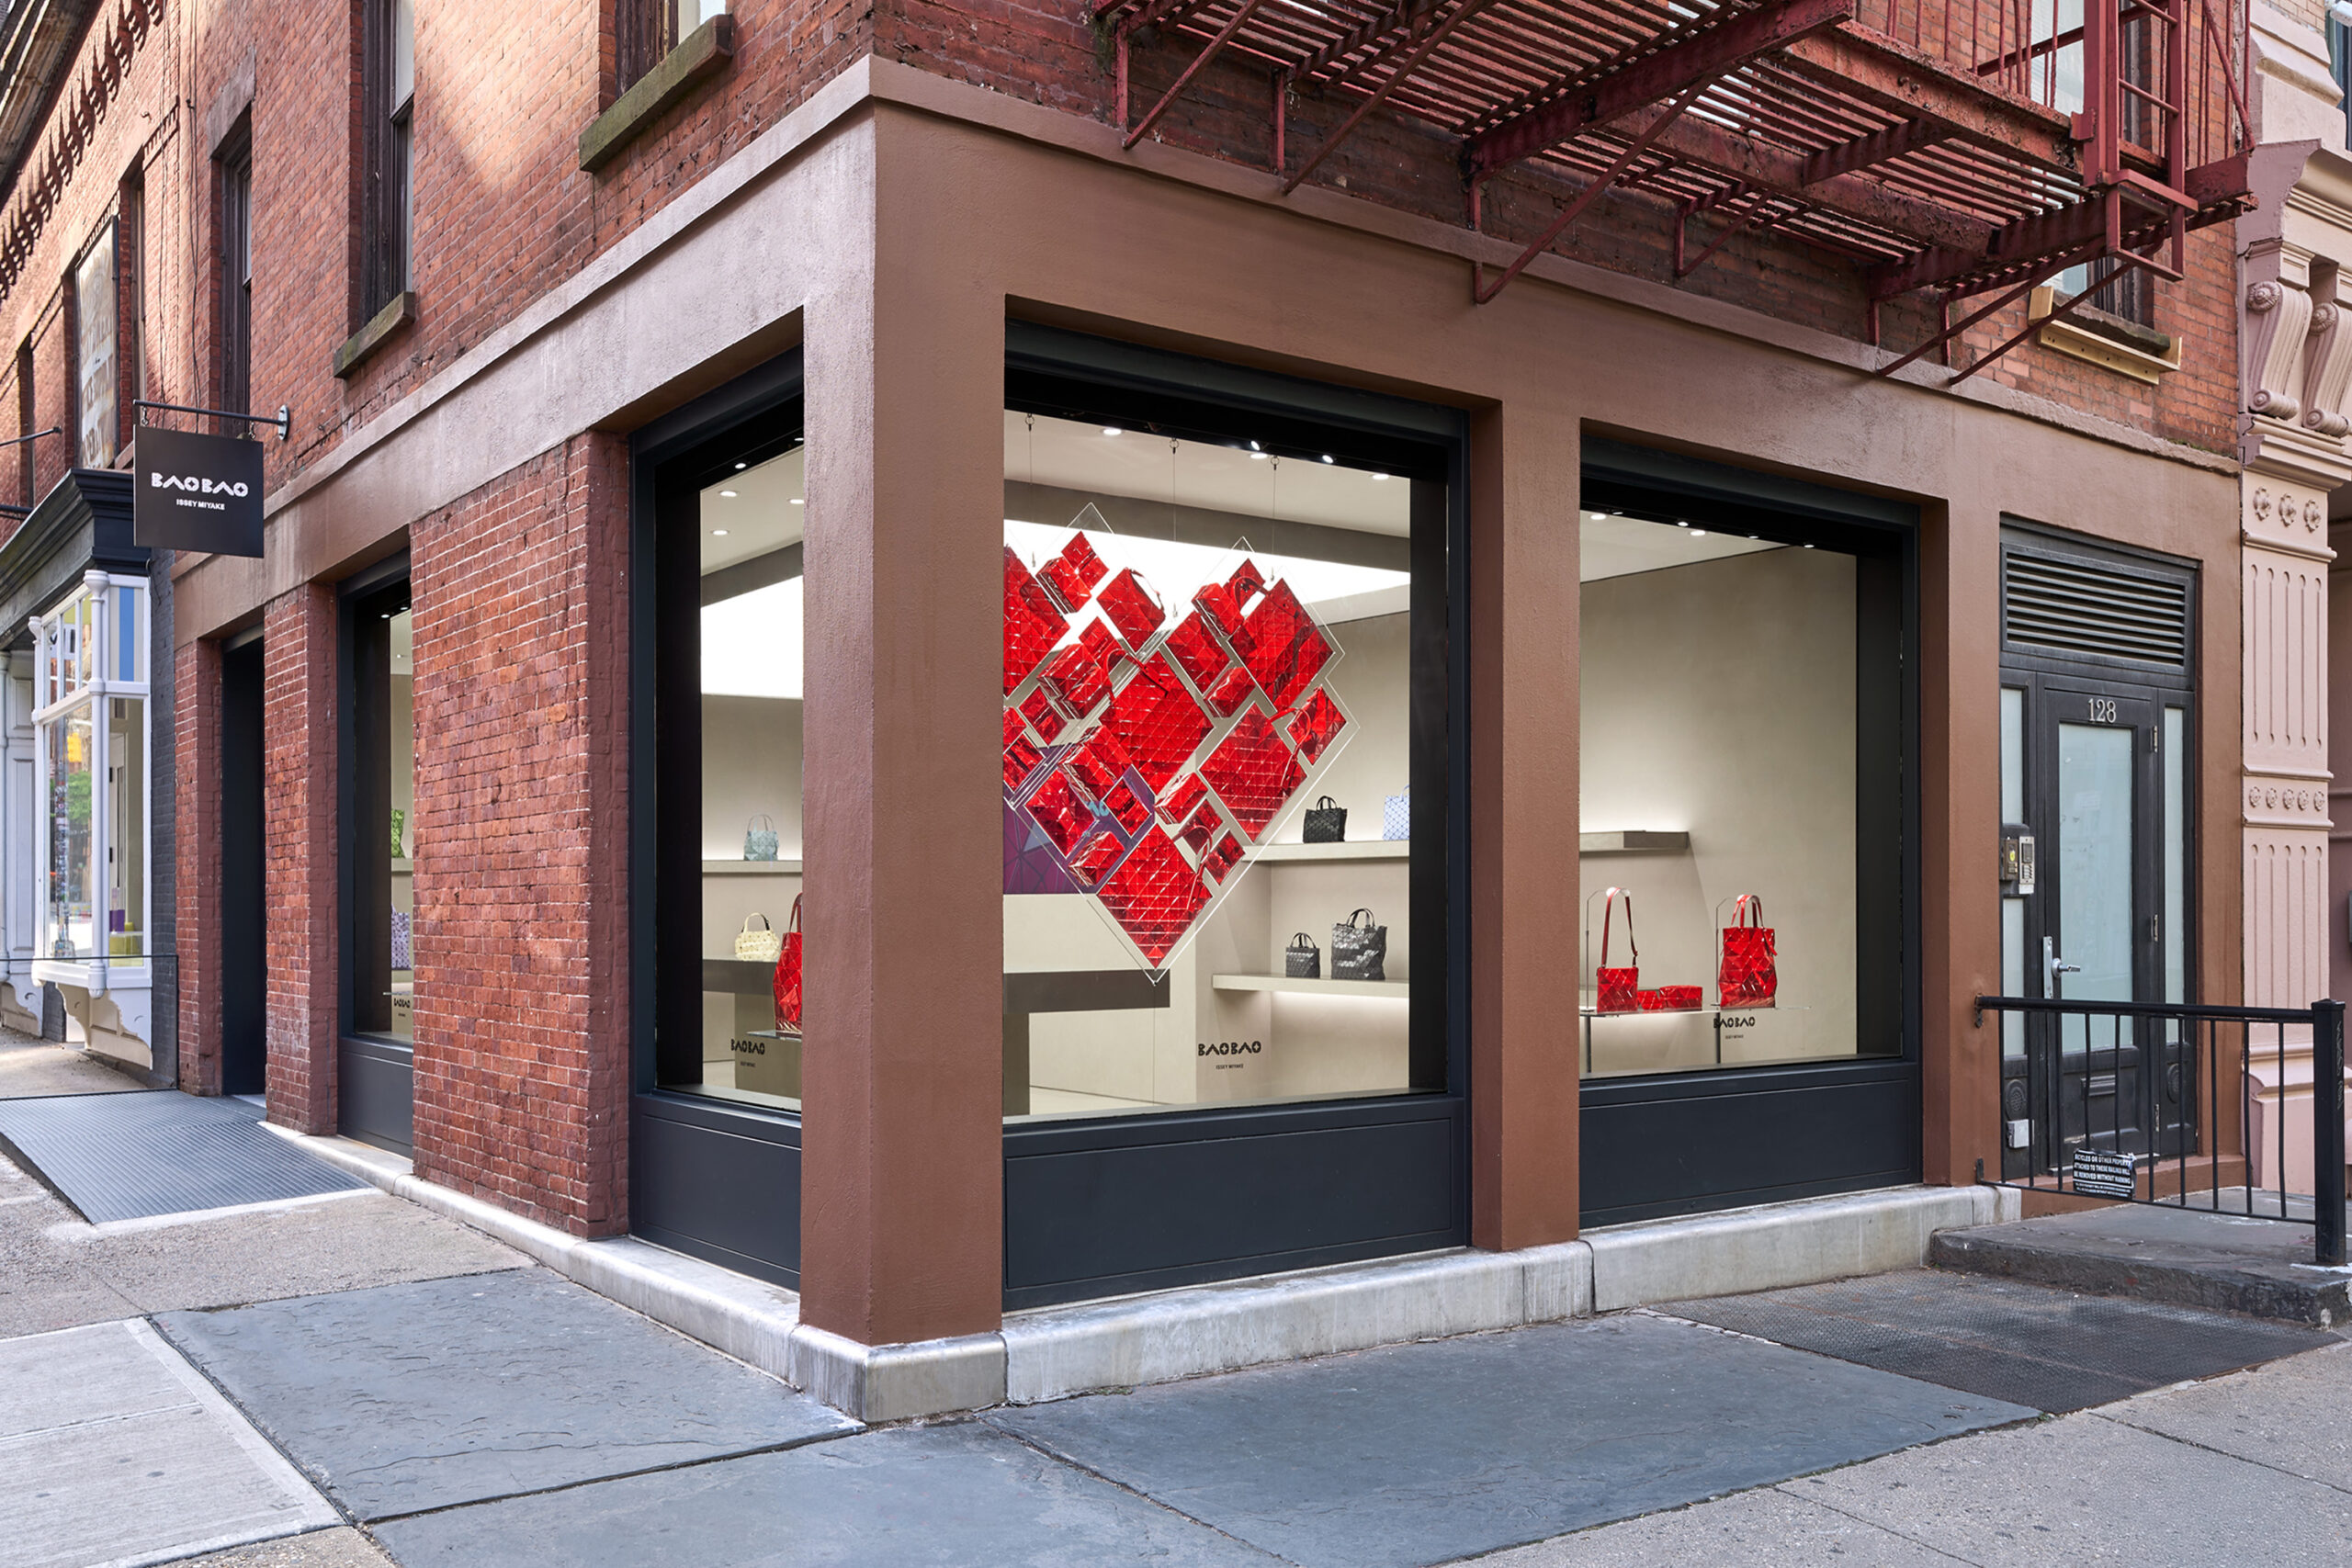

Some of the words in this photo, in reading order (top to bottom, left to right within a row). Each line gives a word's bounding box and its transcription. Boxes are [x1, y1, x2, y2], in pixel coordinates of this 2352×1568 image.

[175, 498, 198, 508] ISSEY
[198, 501, 225, 511] MIYAKE
[2087, 698, 2117, 724] 128
